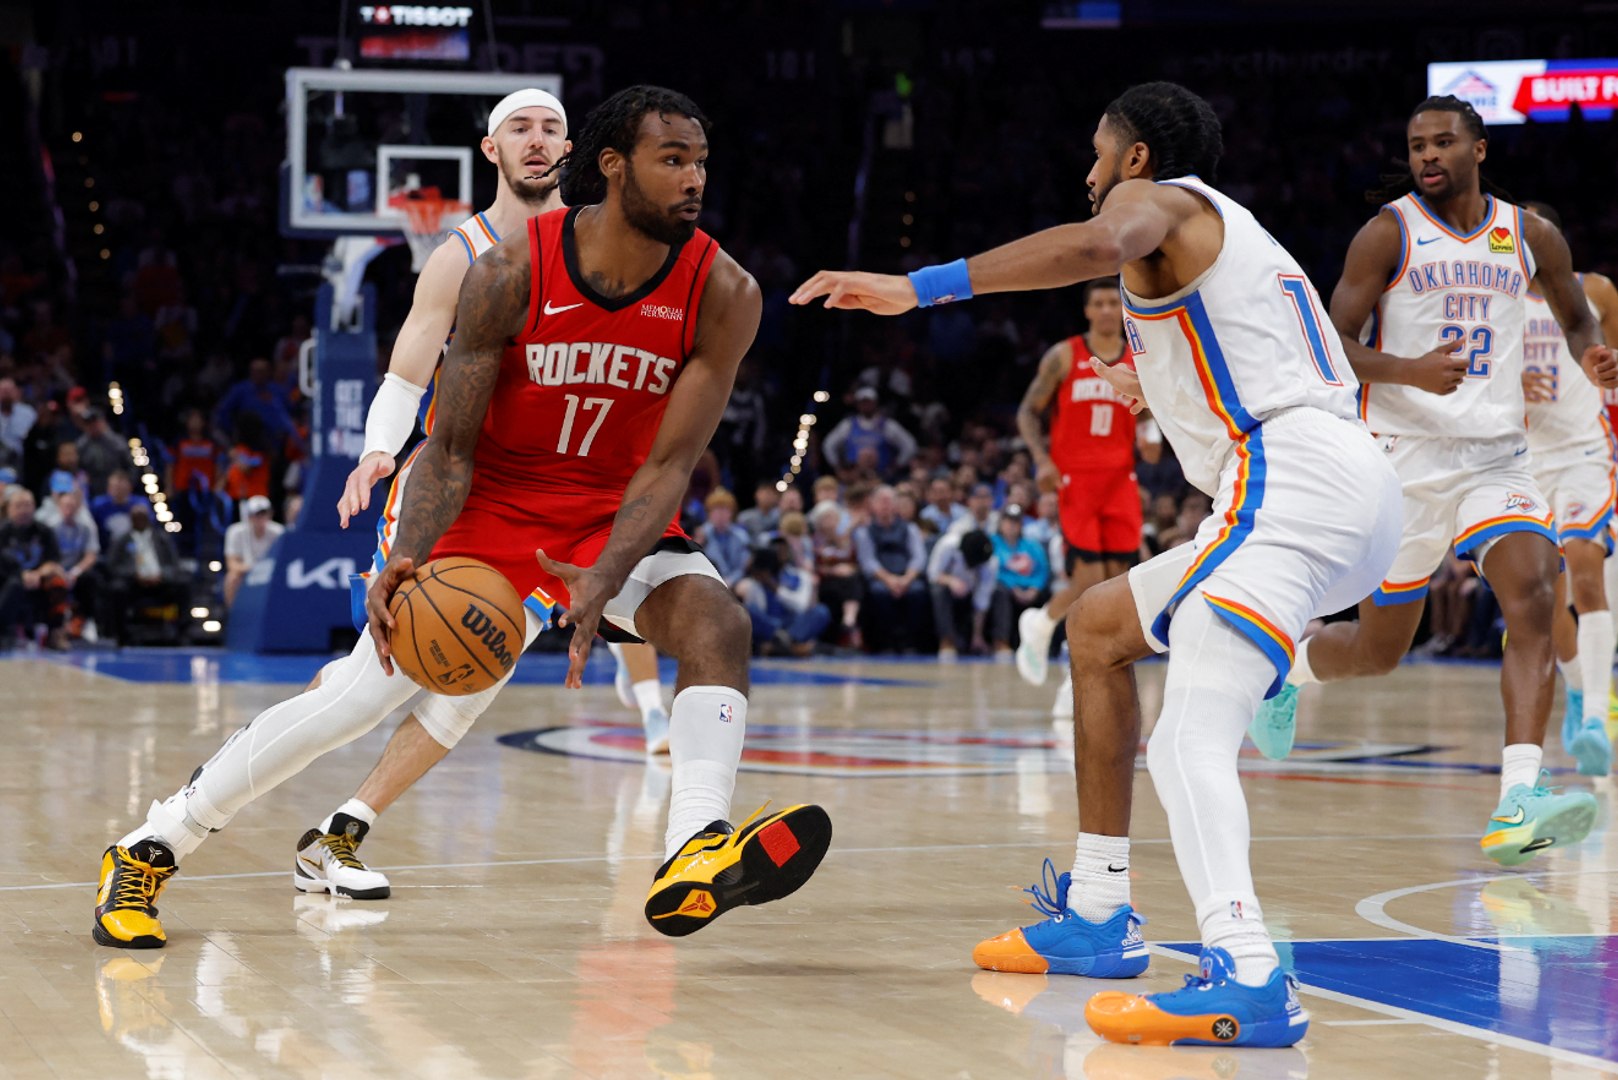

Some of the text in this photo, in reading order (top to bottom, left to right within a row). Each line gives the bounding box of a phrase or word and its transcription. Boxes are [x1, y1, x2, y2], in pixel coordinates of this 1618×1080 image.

[390, 5, 473, 26] TISSOT
[1531, 76, 1600, 102] BUILT
[1408, 260, 1522, 299] OKLAHOMA
[1443, 292, 1493, 321] CITY
[1278, 273, 1344, 387] 1
[525, 342, 677, 395] ROCKETS
[556, 394, 615, 457] 17
[1090, 403, 1114, 437] 10
